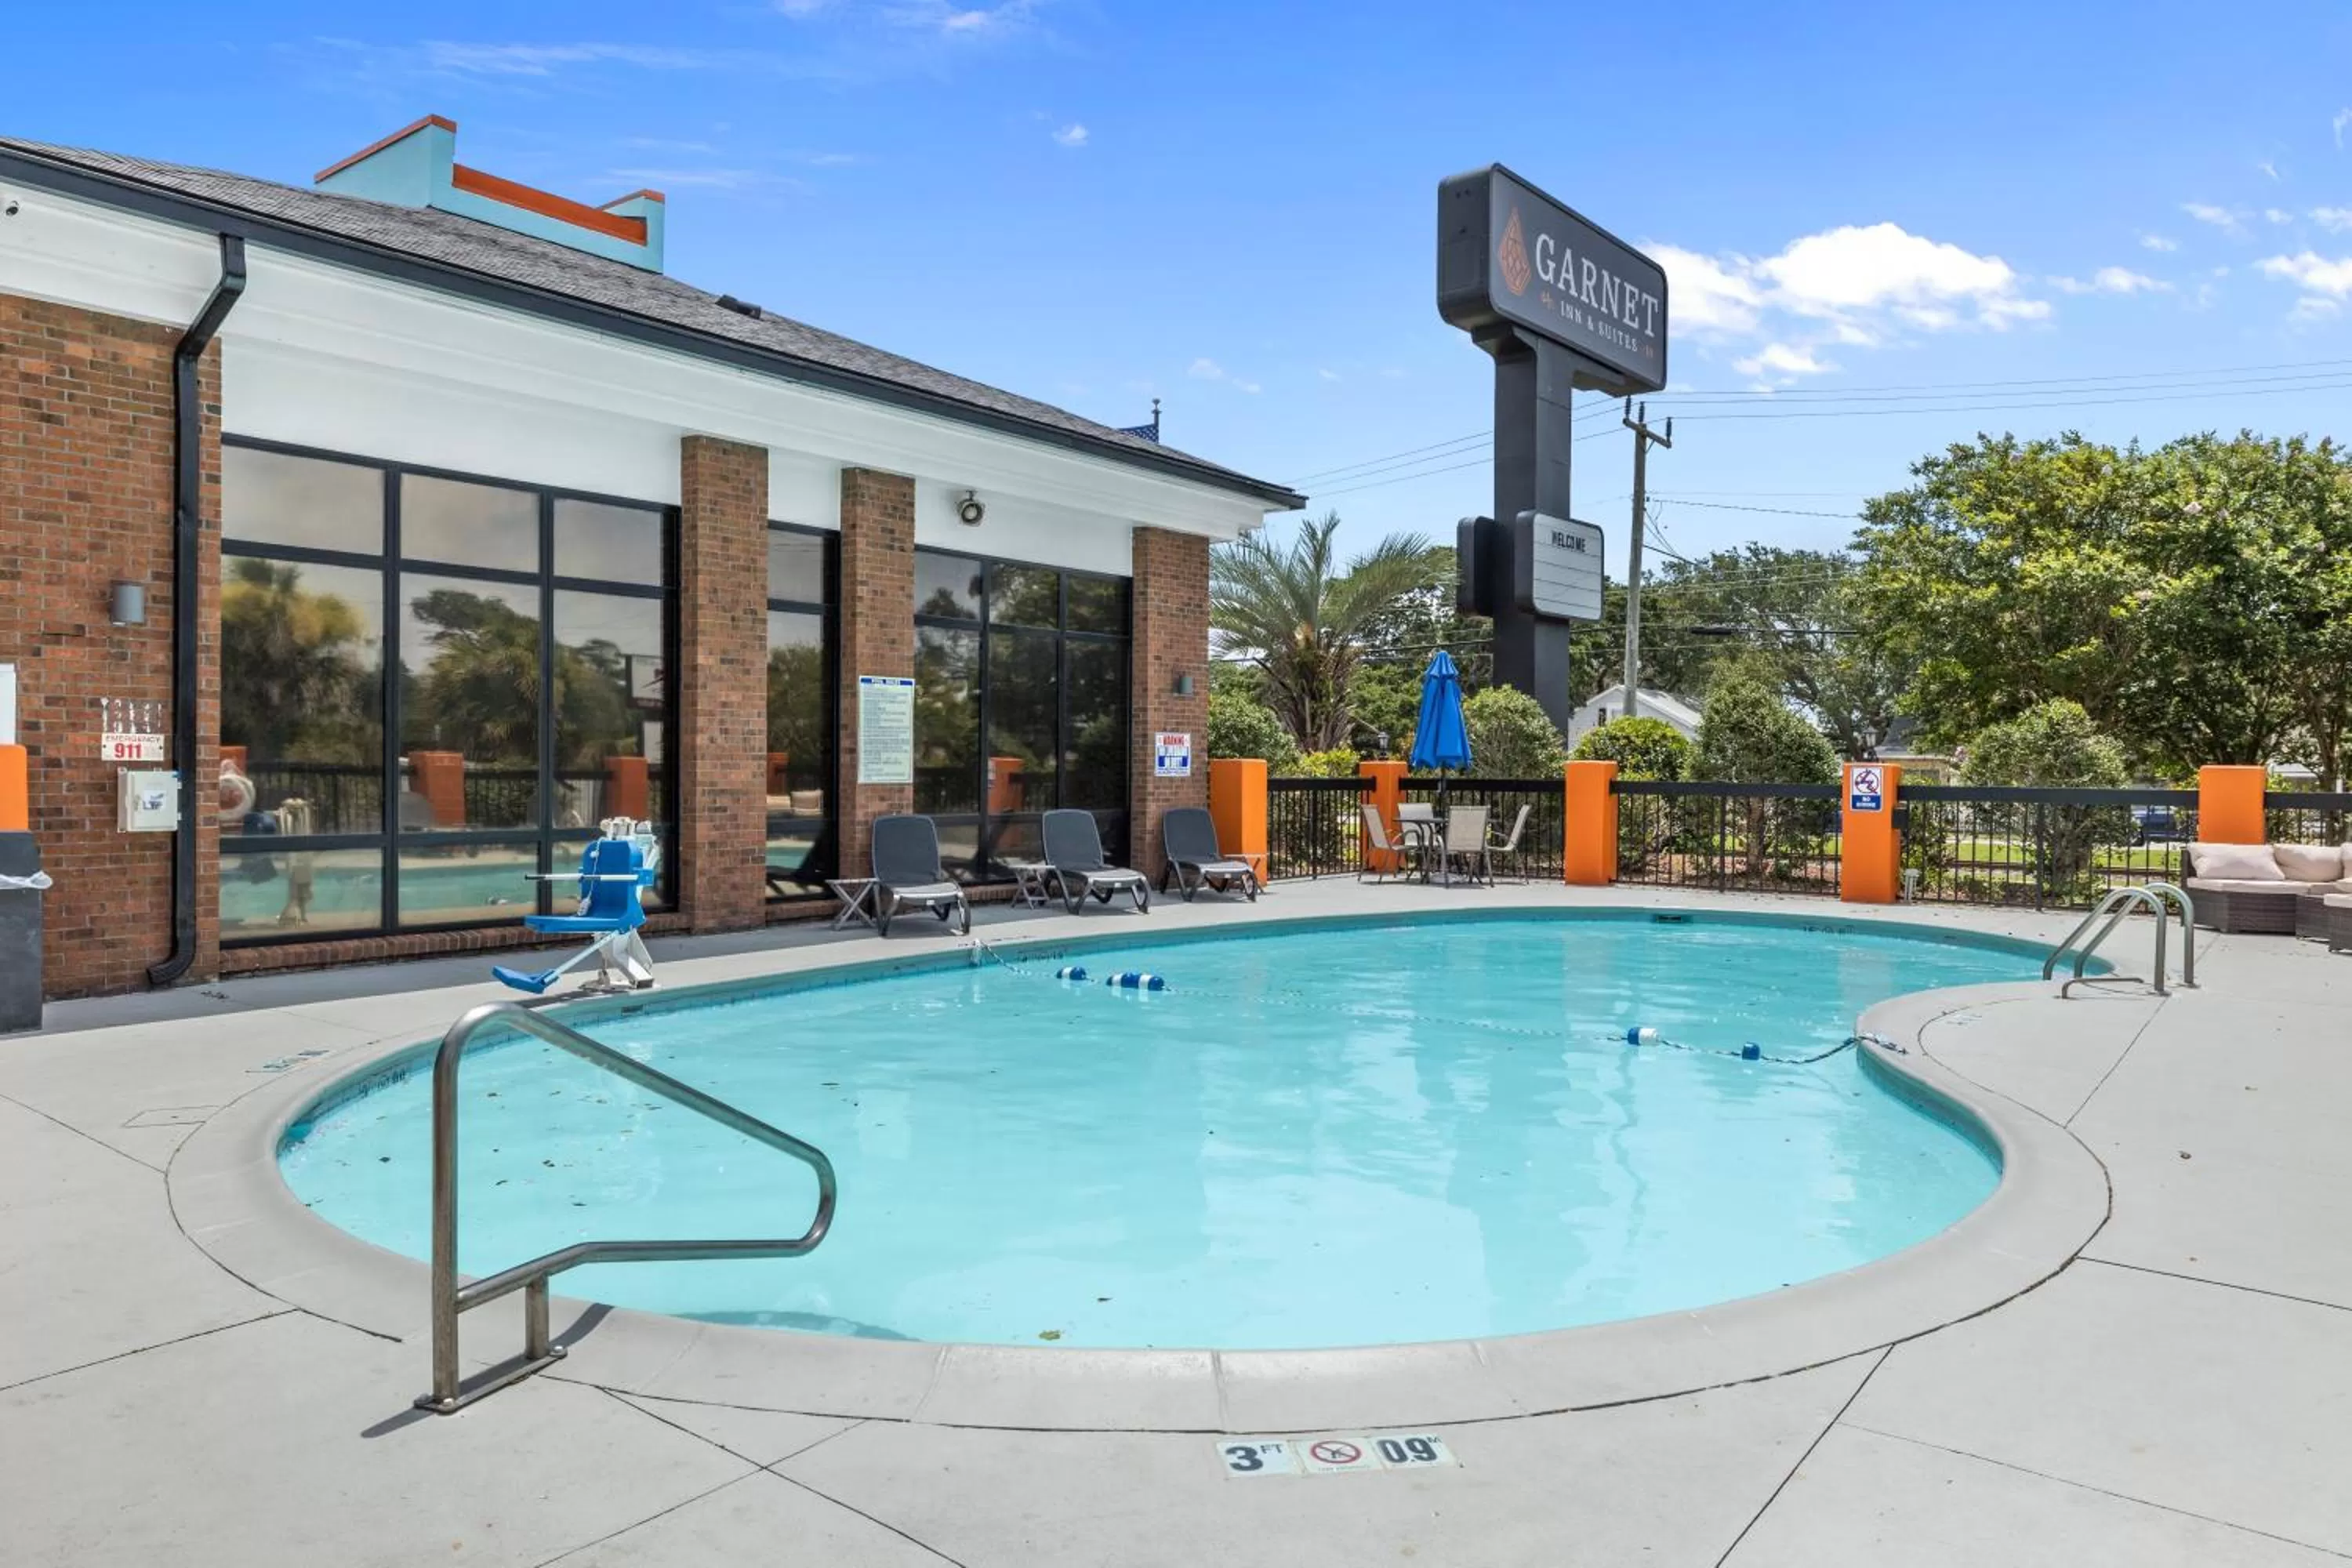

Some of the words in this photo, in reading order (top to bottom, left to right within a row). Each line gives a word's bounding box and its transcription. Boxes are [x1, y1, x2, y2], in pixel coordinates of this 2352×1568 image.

[1535, 233, 1659, 337] GARNET
[1560, 300, 1582, 325] INN
[1599, 321, 1638, 353] SUITES
[1551, 530, 1586, 553] WELCOME
[114, 742, 142, 759] 911
[1225, 1446, 1264, 1472] 3
[1260, 1443, 1283, 1455] FT
